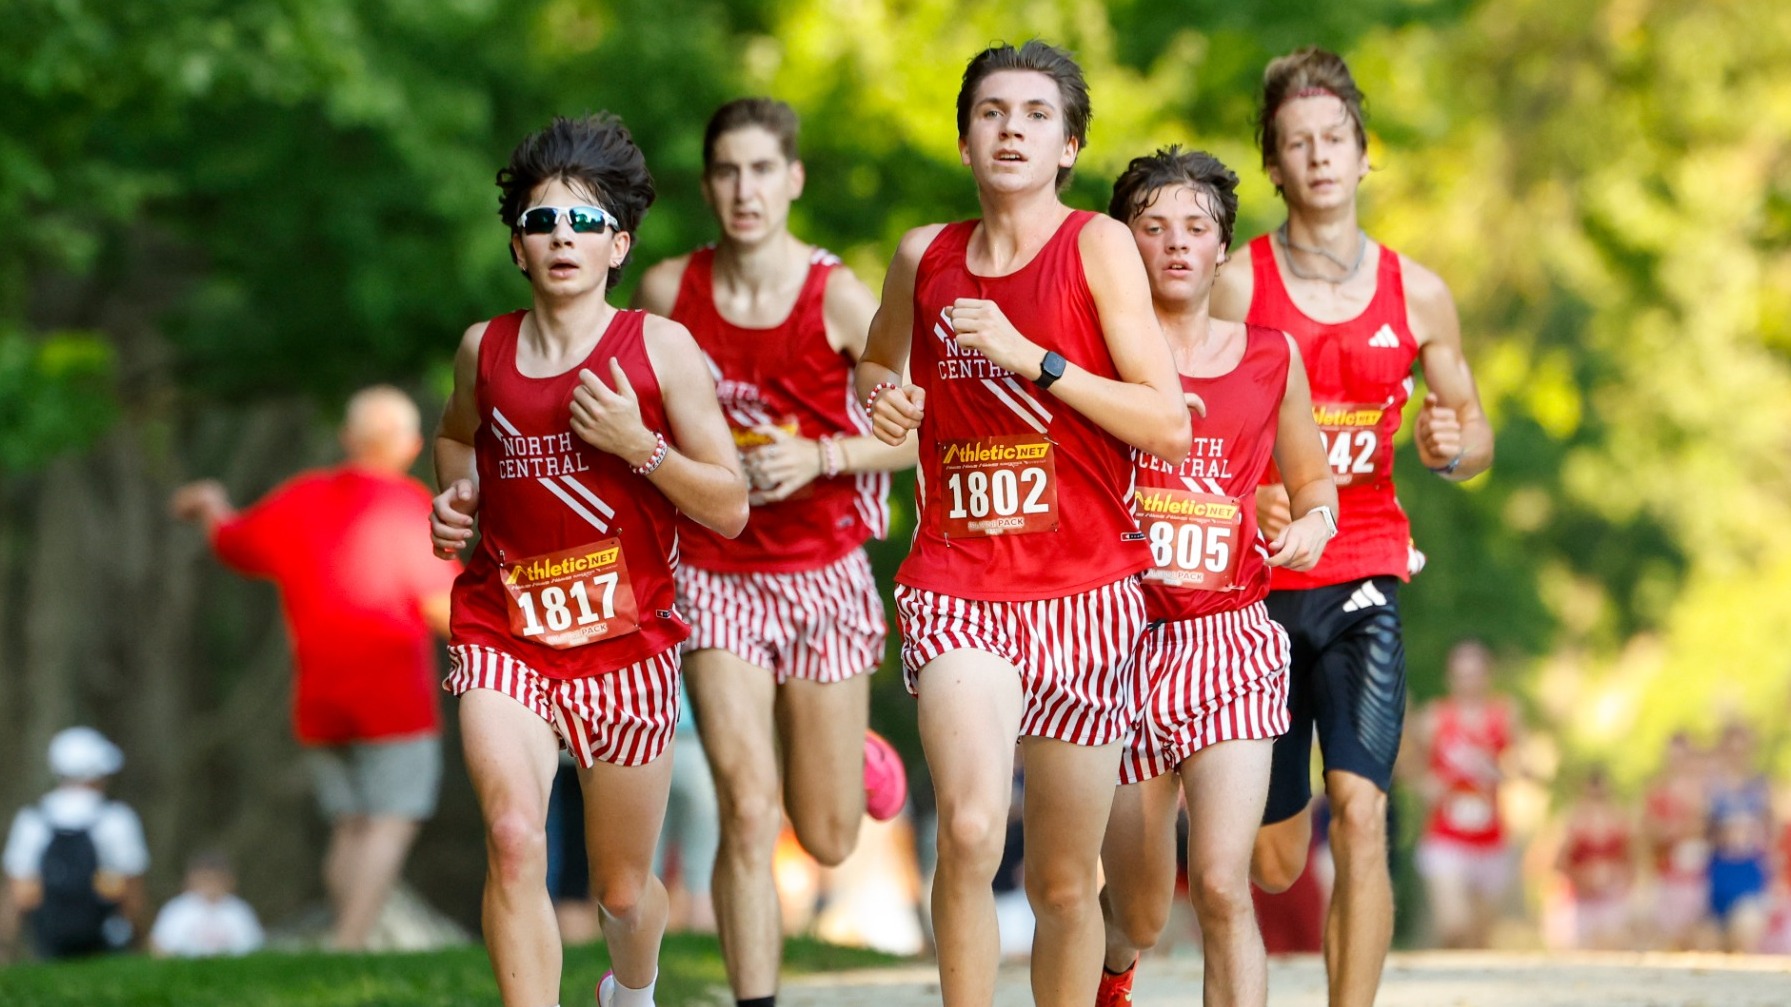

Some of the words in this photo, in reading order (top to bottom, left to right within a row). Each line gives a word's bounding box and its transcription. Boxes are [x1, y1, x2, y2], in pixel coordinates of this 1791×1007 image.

[938, 359, 1015, 380] CENTR
[503, 432, 572, 456] NORTH
[943, 442, 1016, 464] Athletic
[1319, 430, 1377, 474] 42
[500, 453, 589, 479] CENTRAL
[948, 467, 1050, 519] 1802
[998, 518, 1024, 527] PACK
[1148, 521, 1231, 573] 805
[506, 558, 588, 585] Athletic
[517, 571, 619, 637] 1817
[581, 623, 607, 636] PACK
